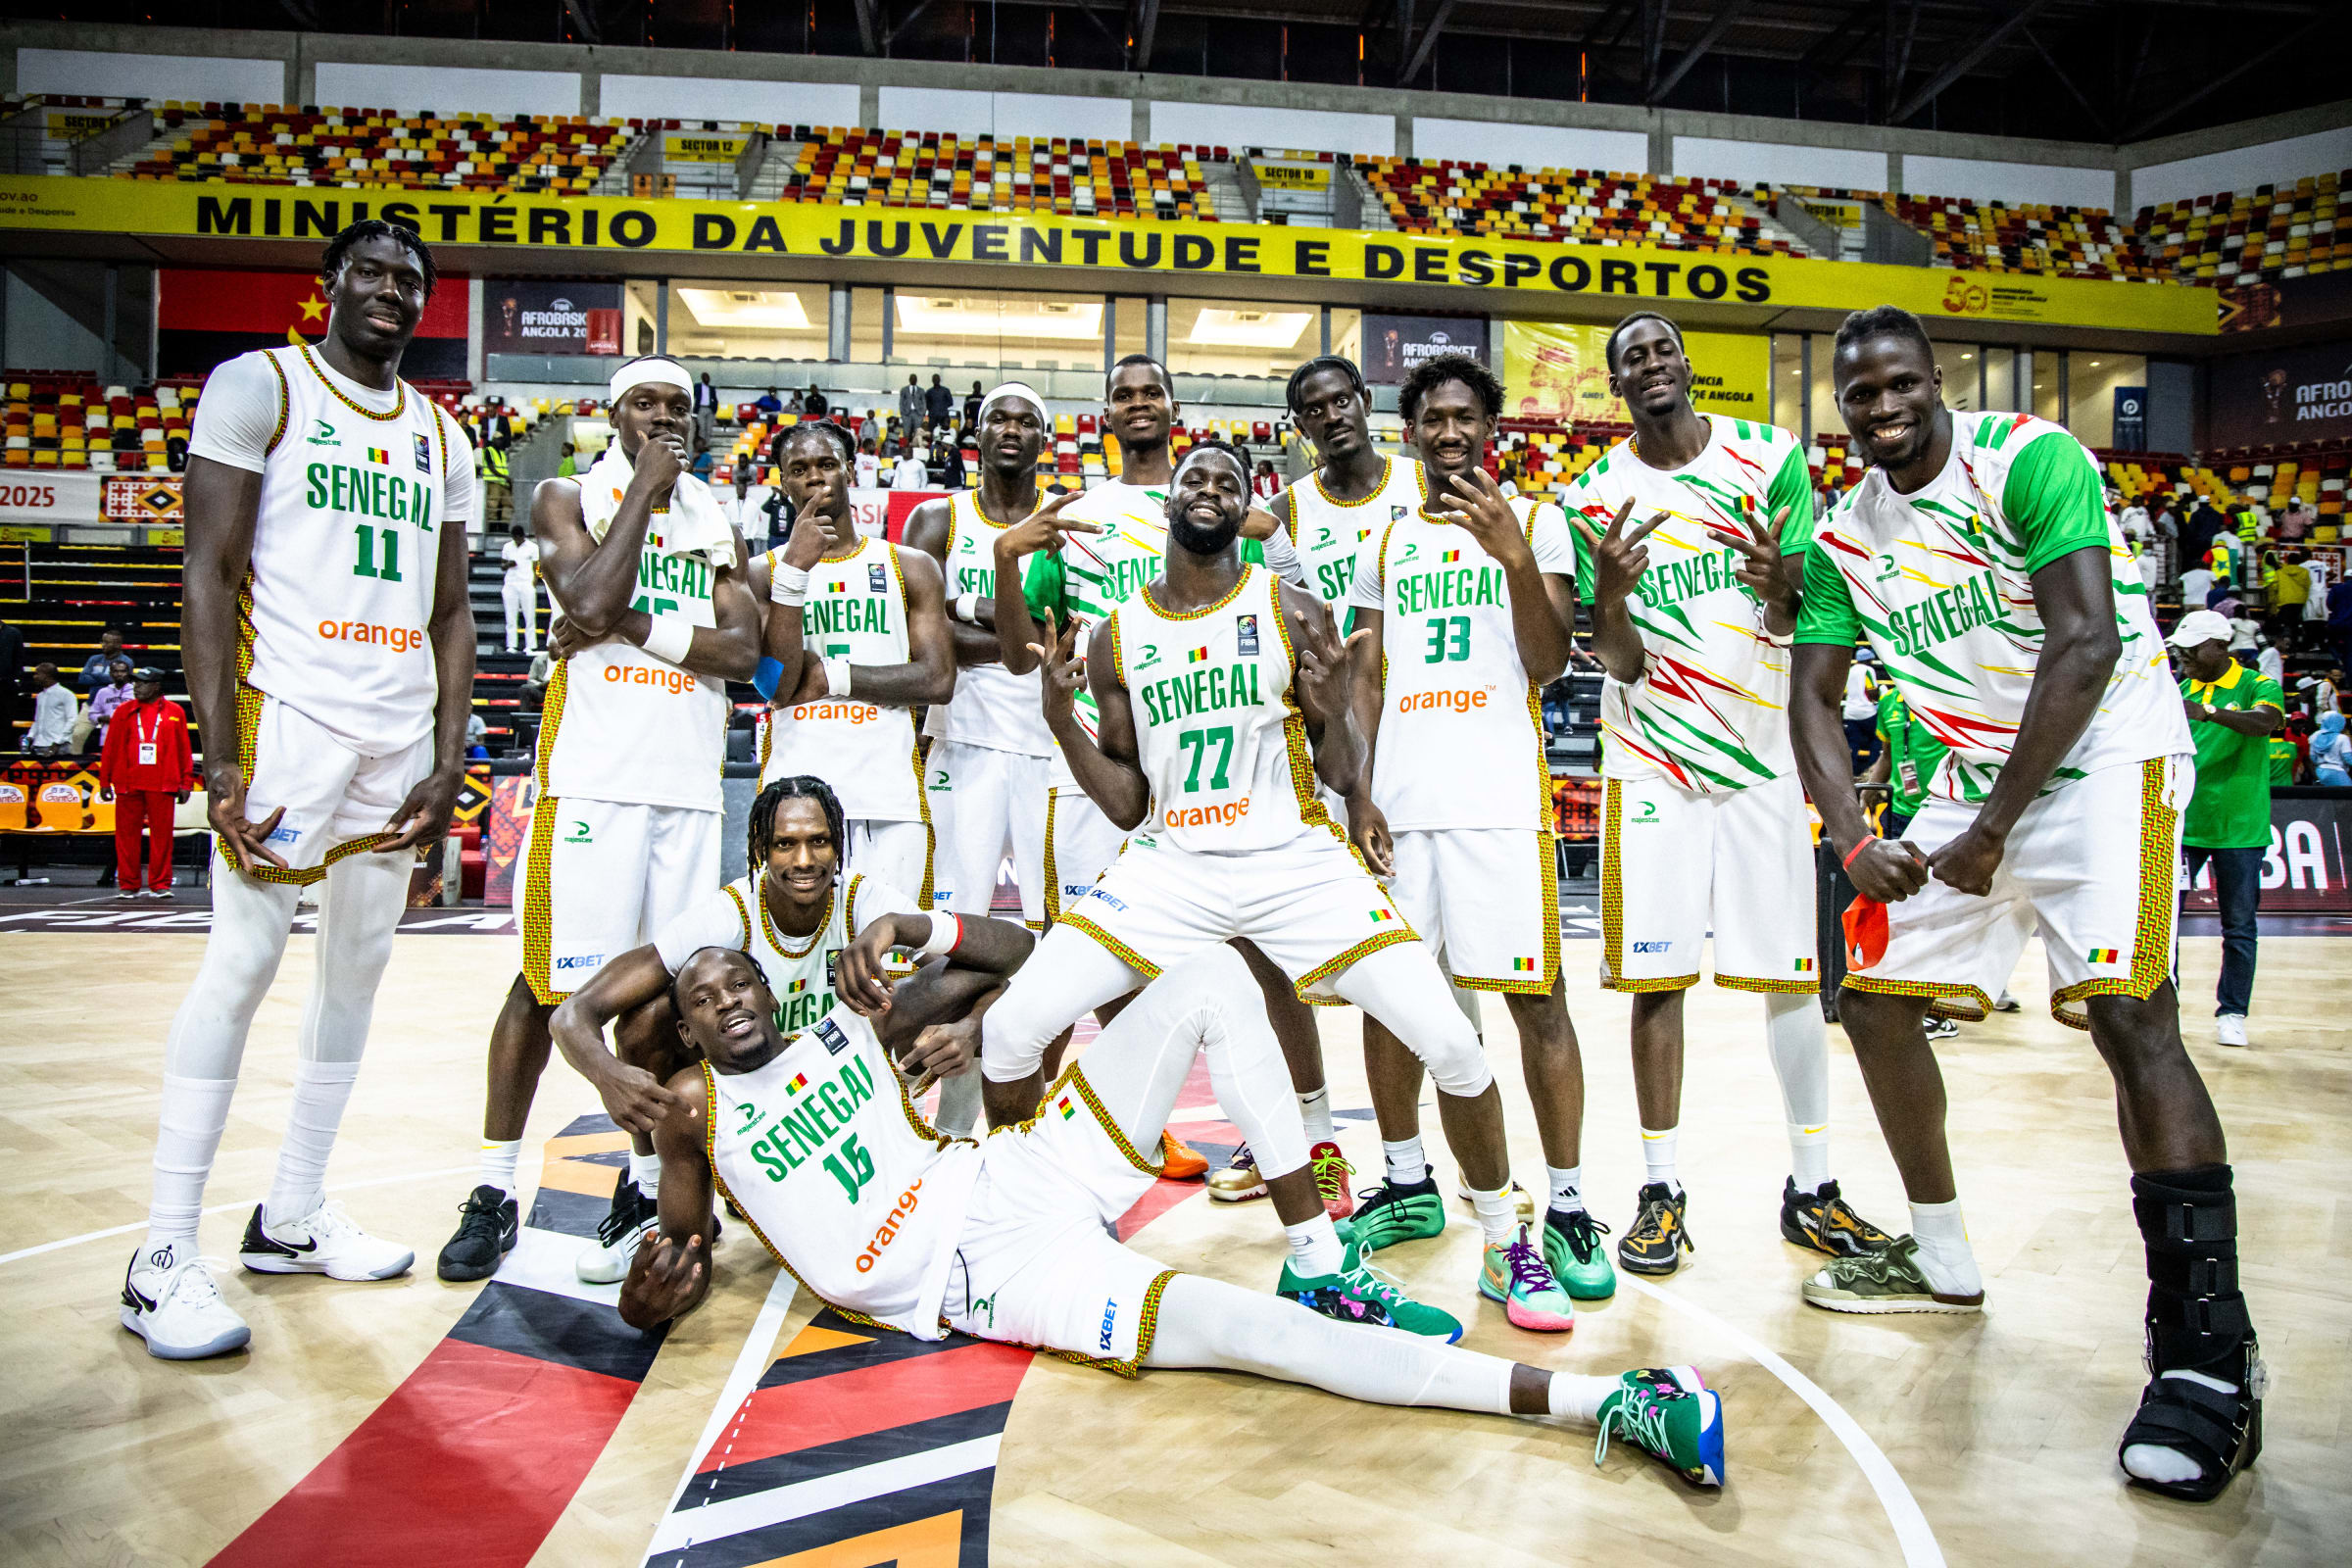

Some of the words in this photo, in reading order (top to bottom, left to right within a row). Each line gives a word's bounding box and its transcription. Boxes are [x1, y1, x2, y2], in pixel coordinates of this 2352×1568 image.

[680, 139, 719, 151] SECTOR
[722, 141, 733, 152] 12
[1264, 167, 1301, 179] SECTOR
[1303, 170, 1315, 180] 10
[197, 194, 657, 248] MINISTÉRIO
[692, 213, 788, 251] DA
[819, 219, 1262, 272] JUVENTUDE
[1295, 241, 1332, 275] E
[1364, 243, 1772, 303] DESPORTOS
[521, 312, 587, 325] AFROBASK
[521, 327, 570, 337] ANGOLA
[573, 328, 587, 337] 20
[1709, 391, 1754, 403] ANGOLA
[0, 485, 55, 508] 2025
[307, 463, 433, 533] SENEGAL
[353, 524, 403, 582] 11
[639, 552, 711, 600] NEGAL
[1101, 556, 1166, 600] SENE
[1396, 565, 1505, 616] SENEGAL
[1639, 548, 1744, 608] SENEGA
[803, 598, 891, 635] ENEGAL
[1888, 569, 2011, 657] SENEGAL
[318, 619, 423, 653] orange
[1424, 615, 1471, 664] 33
[604, 664, 696, 695] orange
[1142, 663, 1265, 727] SENEGAL
[793, 704, 878, 724] orange
[1399, 689, 1488, 713] orange
[1179, 725, 1235, 793] 77
[1165, 797, 1250, 827] orange
[269, 827, 303, 843] BET
[933, 891, 954, 901] BET
[1064, 885, 1094, 896] 1XB
[1090, 889, 1129, 912] 1XBET
[557, 954, 606, 969] 1XBET
[1633, 941, 1673, 953] 1XBET
[773, 992, 835, 1032] NEGA
[1099, 1297, 1118, 1351] 1XBET
